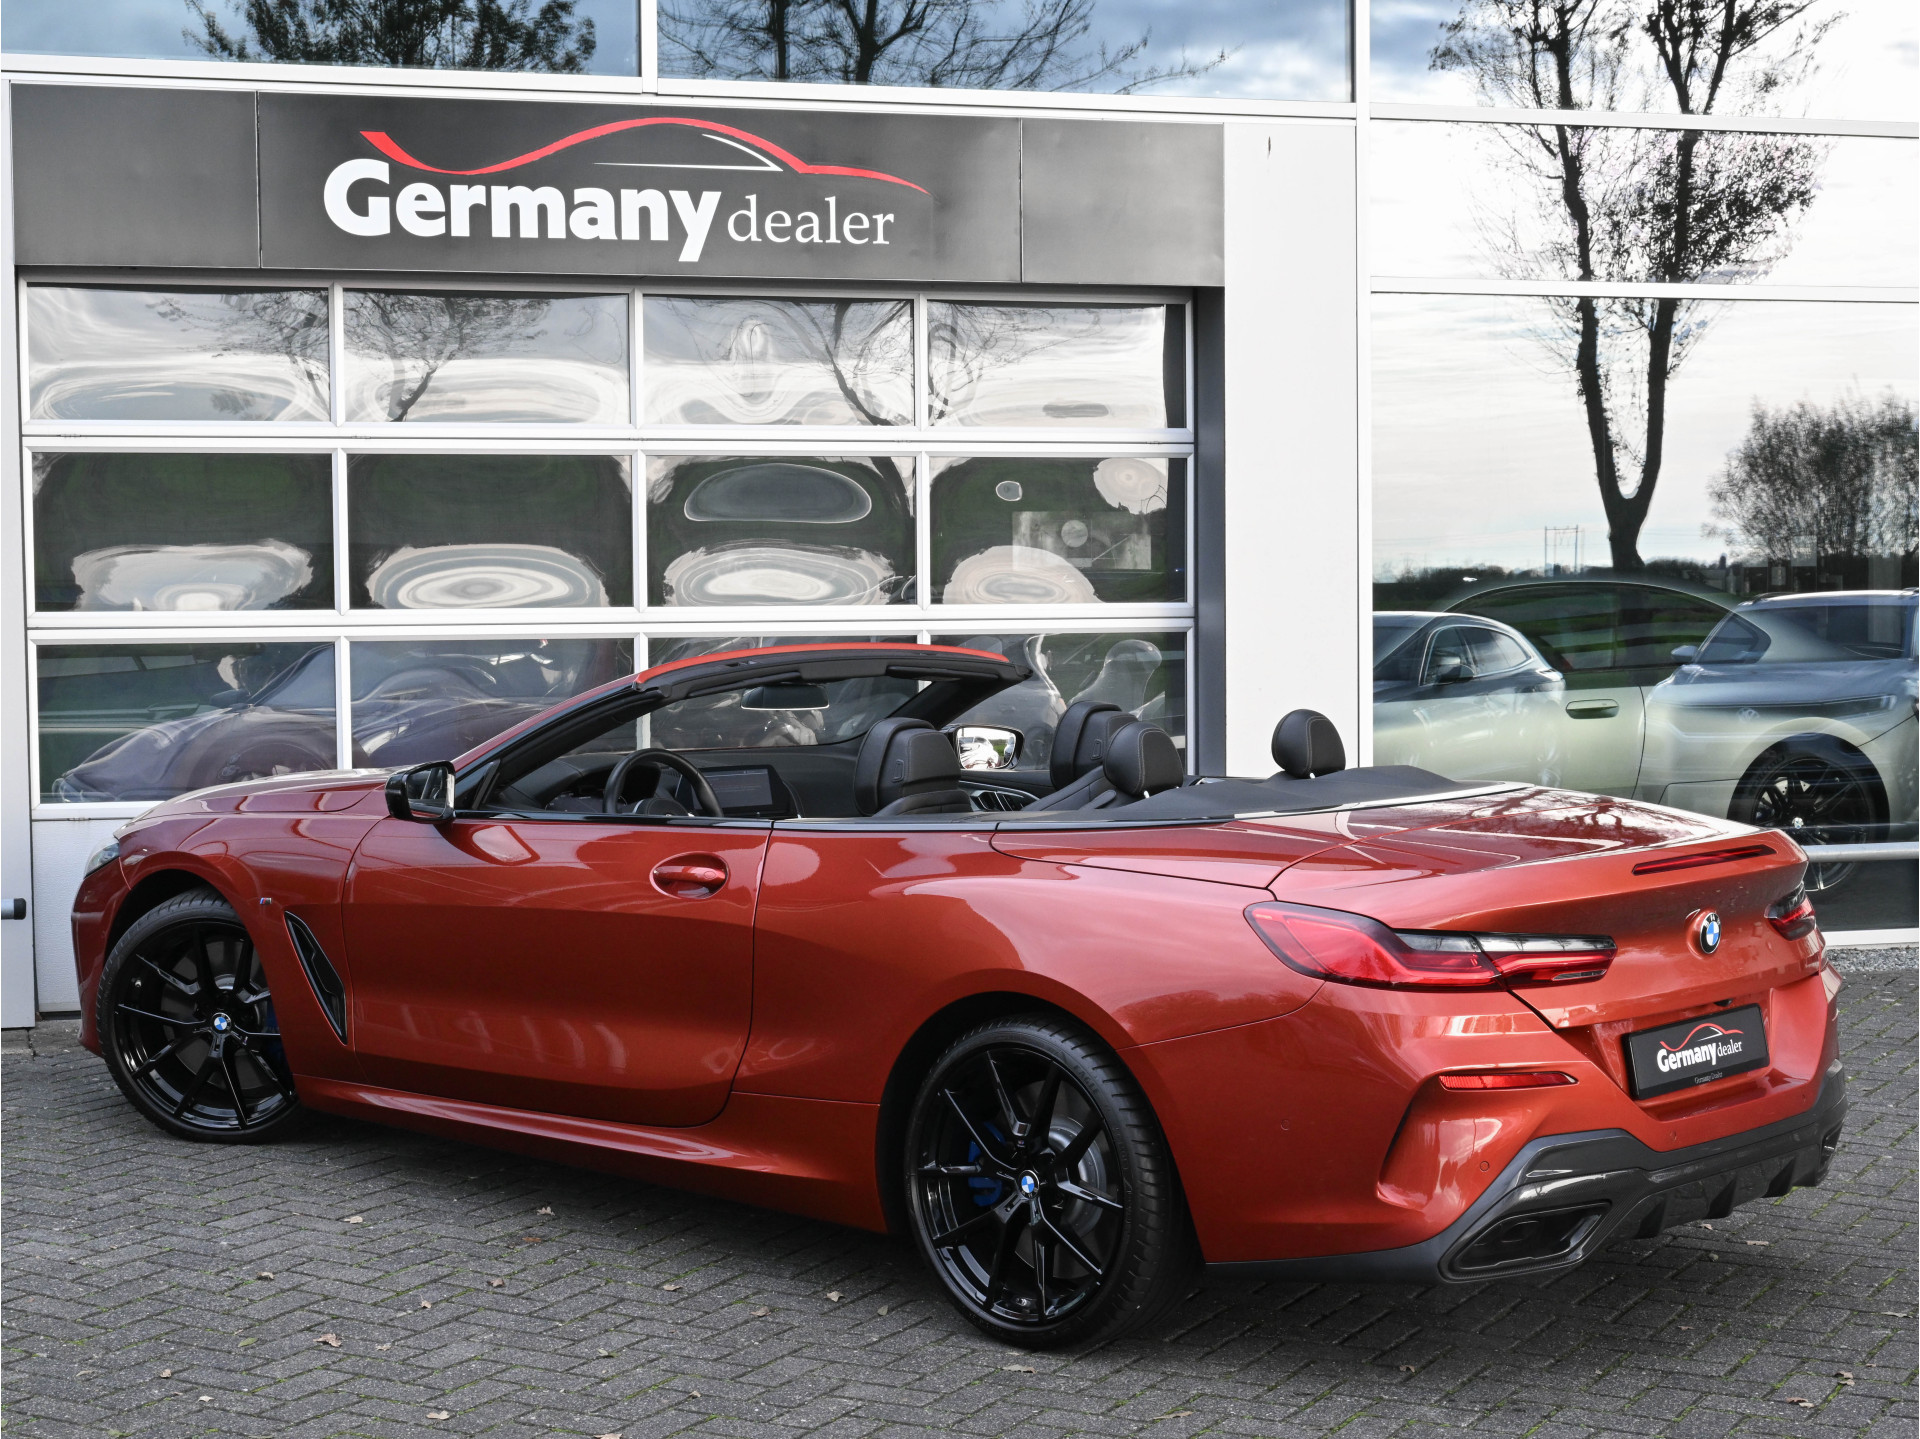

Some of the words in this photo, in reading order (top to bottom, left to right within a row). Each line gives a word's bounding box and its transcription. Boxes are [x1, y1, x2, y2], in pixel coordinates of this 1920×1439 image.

[323, 158, 722, 262] Germany
[726, 195, 895, 245] dealer
[1657, 1042, 1717, 1073] Germany
[1717, 1038, 1742, 1057] dealer
